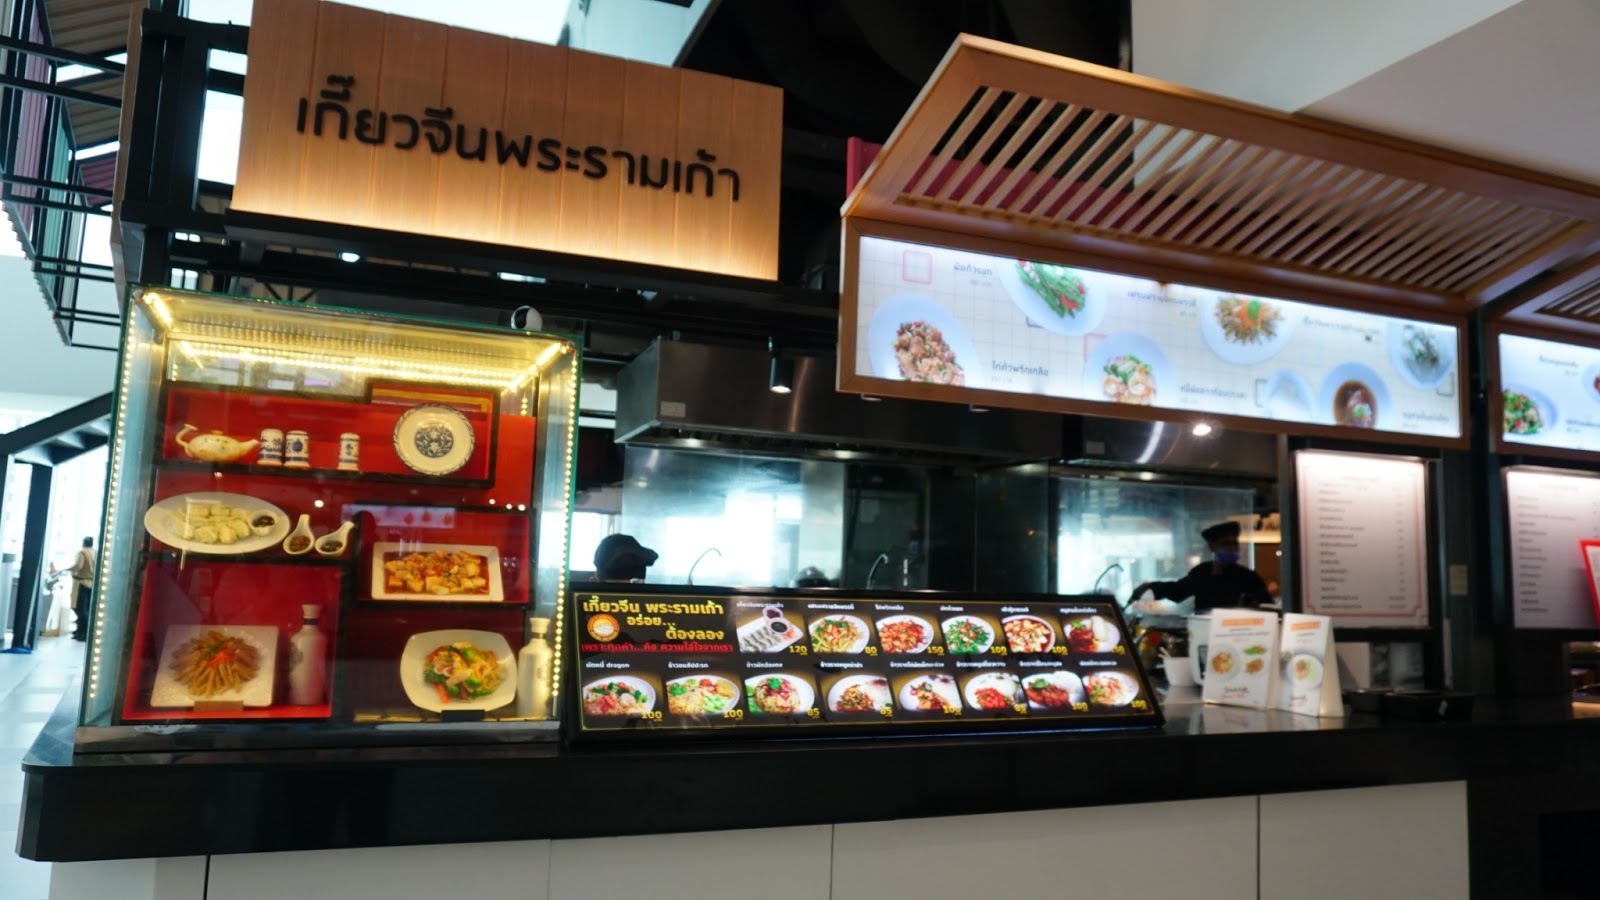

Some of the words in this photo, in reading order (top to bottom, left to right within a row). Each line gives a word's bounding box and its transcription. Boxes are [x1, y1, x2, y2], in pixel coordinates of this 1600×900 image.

[296, 73, 740, 202] เกี๊ยวจีนพระรามเก้า
[583, 595, 640, 613] เกี๊ยวจีน
[645, 600, 724, 615] พระรามเก้า
[626, 614, 676, 626] อร่อย...
[665, 625, 724, 640] ต้องลอง
[789, 645, 807, 653] 120
[864, 646, 877, 654] 80
[927, 646, 944, 654] 150
[990, 646, 1007, 654] 100
[1052, 646, 1067, 654] 100
[606, 662, 630, 670] dragon
[642, 710, 662, 719] 100
[723, 709, 743, 719] 100
[807, 708, 819, 716] 85
